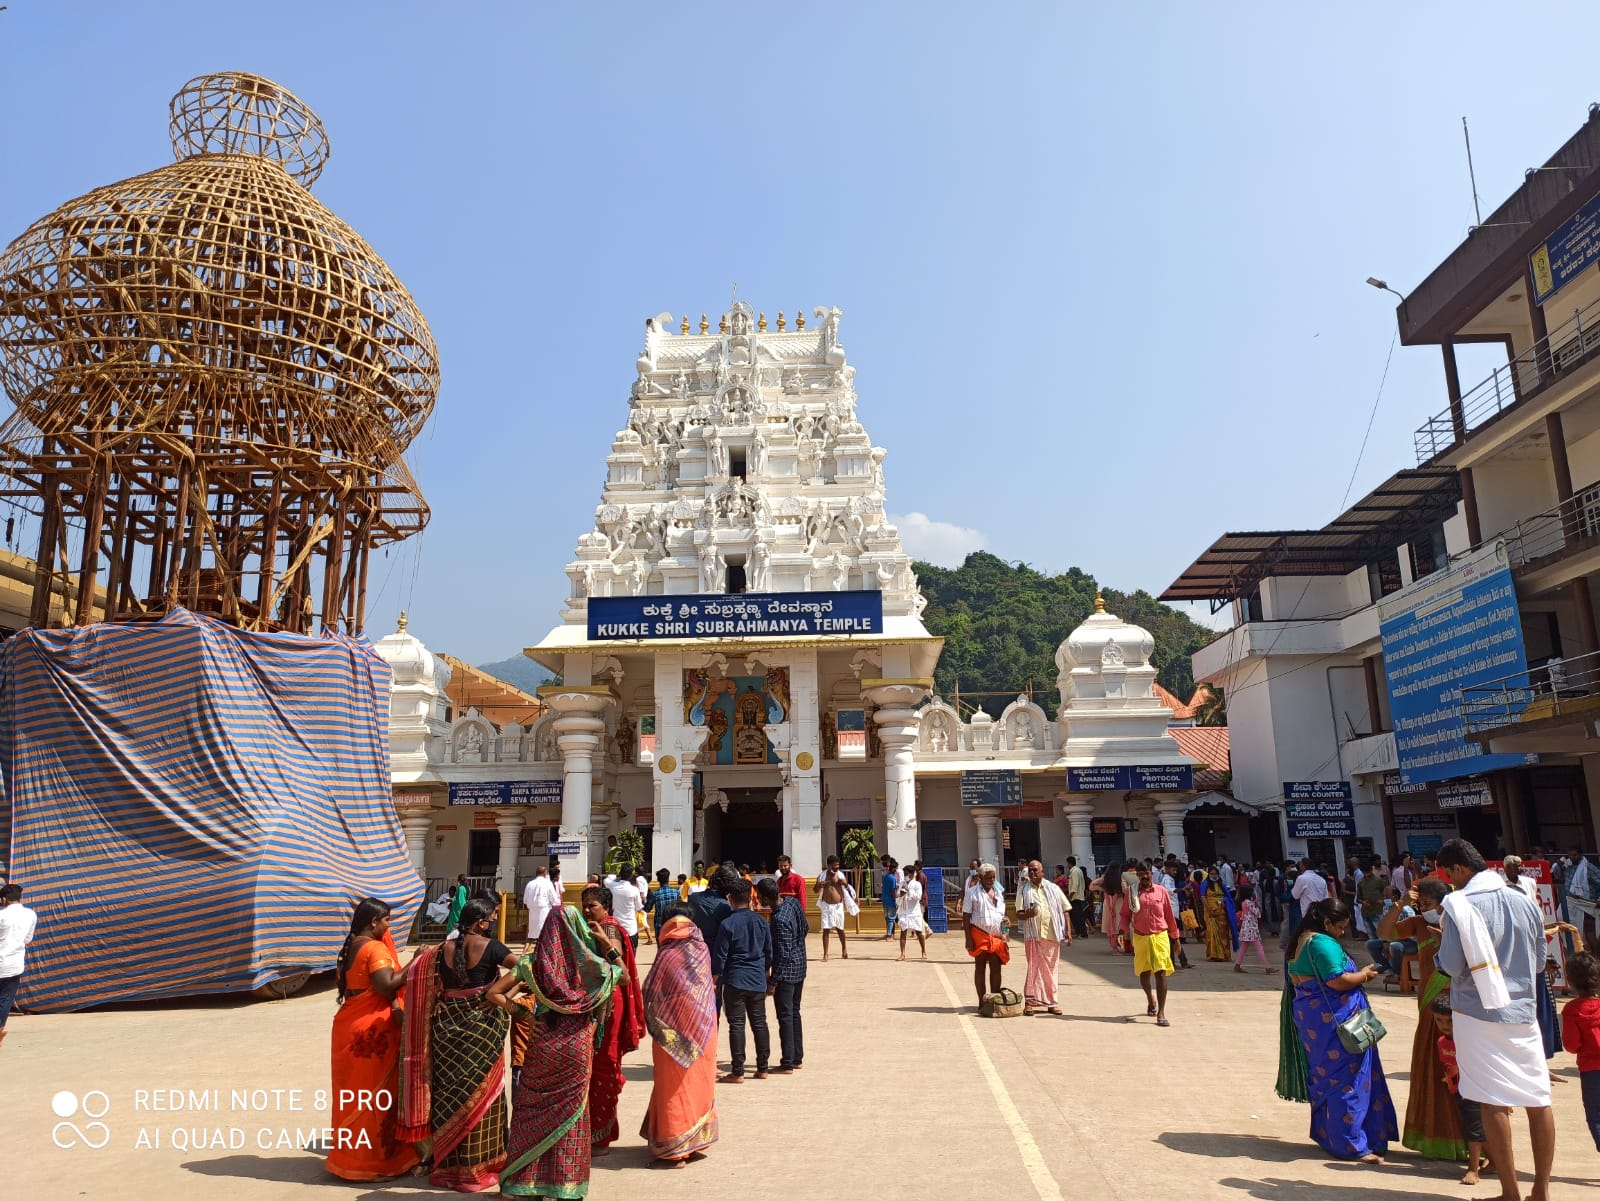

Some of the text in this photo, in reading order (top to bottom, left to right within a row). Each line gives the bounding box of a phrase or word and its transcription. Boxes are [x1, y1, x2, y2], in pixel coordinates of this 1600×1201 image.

[642, 604, 674, 620] ಕುಕ್ಕೆ
[679, 604, 698, 618] ಶ್ರೀ
[704, 602, 762, 620] ಸುಬ್ರಹ್ಮಣ್ಯ
[768, 600, 833, 618] ದೇವಸ್ಥಾನ
[598, 618, 872, 636] KUKKE SHRI SUBRAHMANYA TEMPLE
[1386, 785, 1400, 794] SEVA
[1438, 794, 1481, 808] LUGGAGE ROOM
